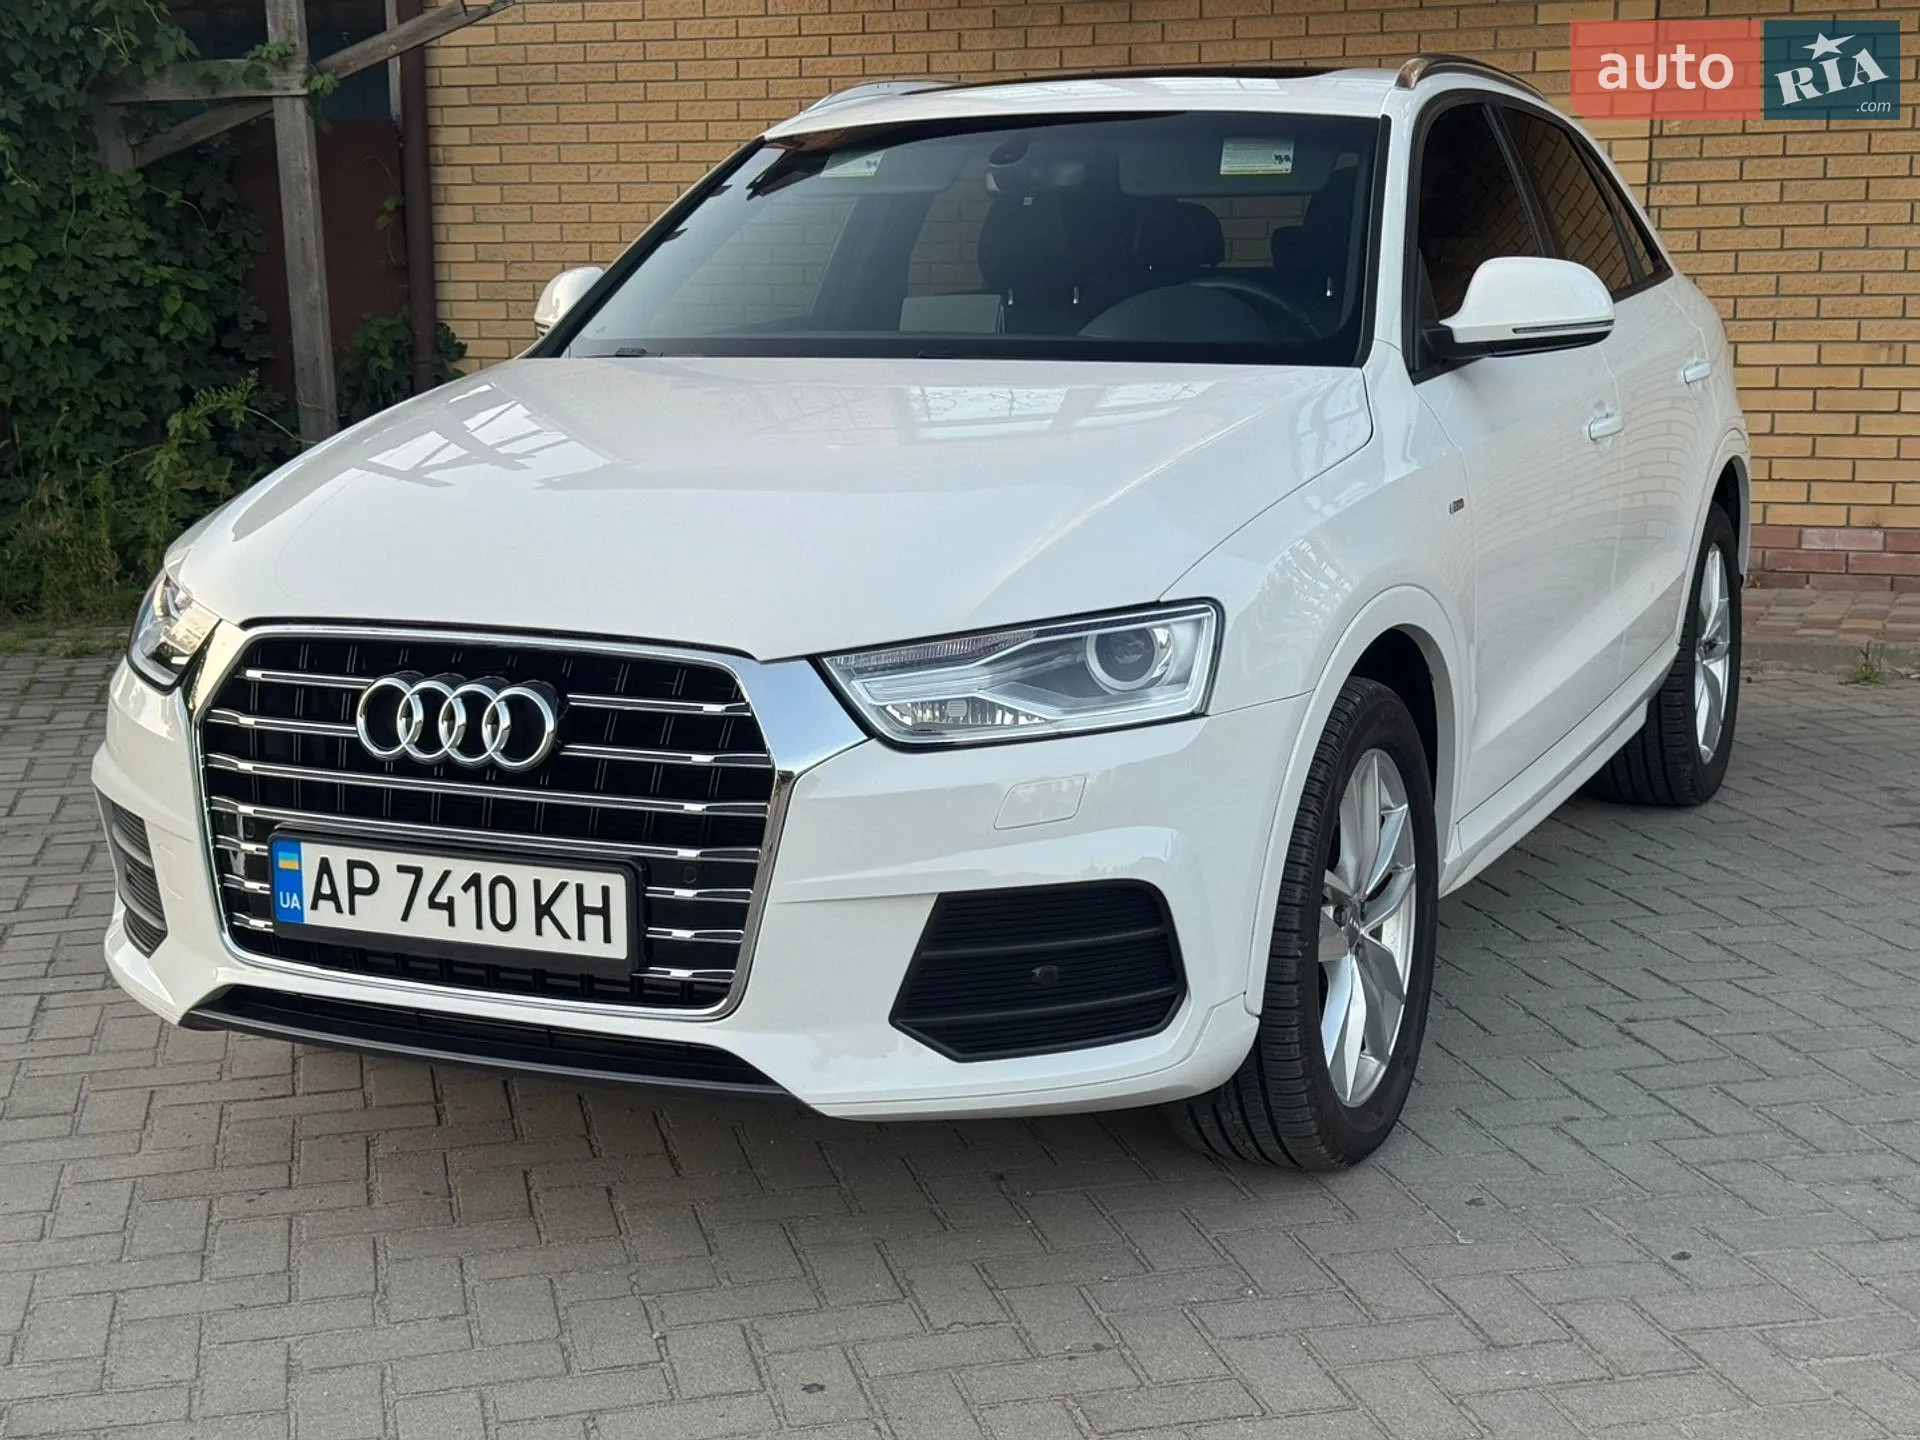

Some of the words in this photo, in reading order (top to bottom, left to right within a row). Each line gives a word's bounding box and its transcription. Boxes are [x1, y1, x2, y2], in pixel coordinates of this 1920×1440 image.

[279, 891, 301, 910] UA
[310, 856, 380, 916] AP
[396, 864, 517, 932] 7410
[533, 878, 612, 944] KH
